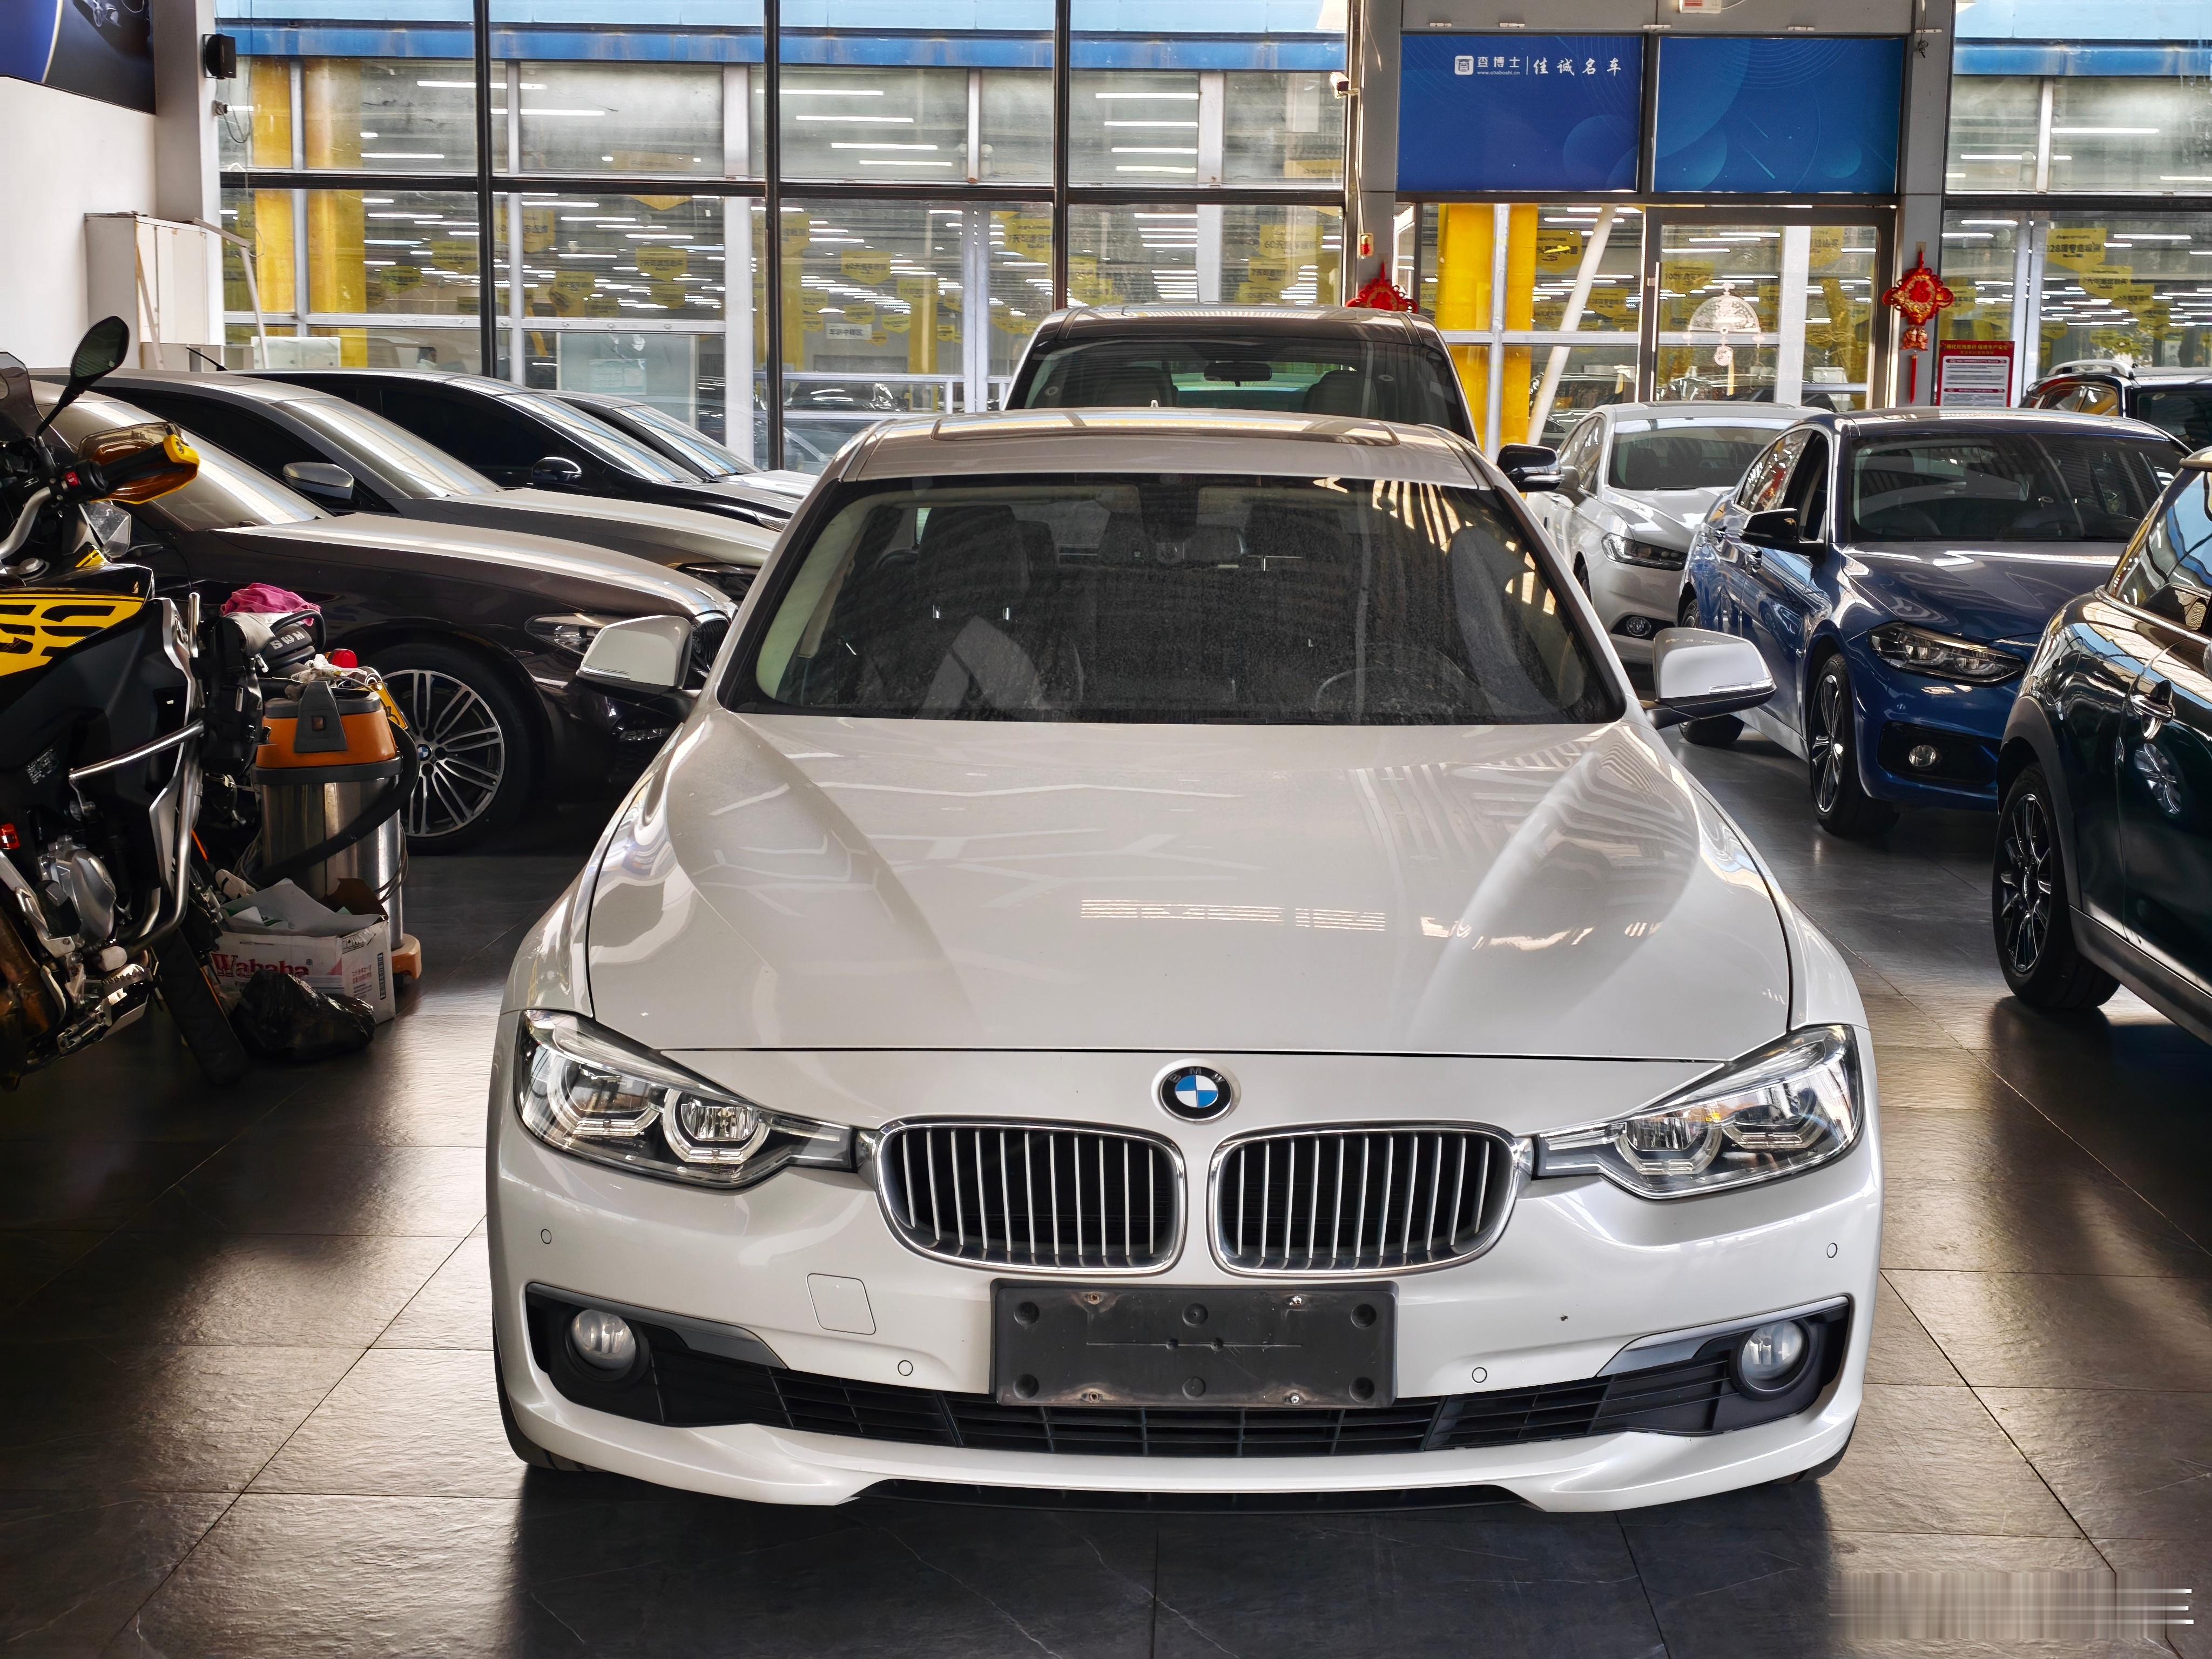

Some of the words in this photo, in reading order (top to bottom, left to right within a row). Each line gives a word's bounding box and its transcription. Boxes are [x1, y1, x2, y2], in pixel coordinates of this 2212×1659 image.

[1477, 56, 1521, 68] 查博士
[1533, 56, 1621, 77] 佳诚名车
[269, 631, 305, 650] SWM
[1168, 1067, 1226, 1083] BMW
